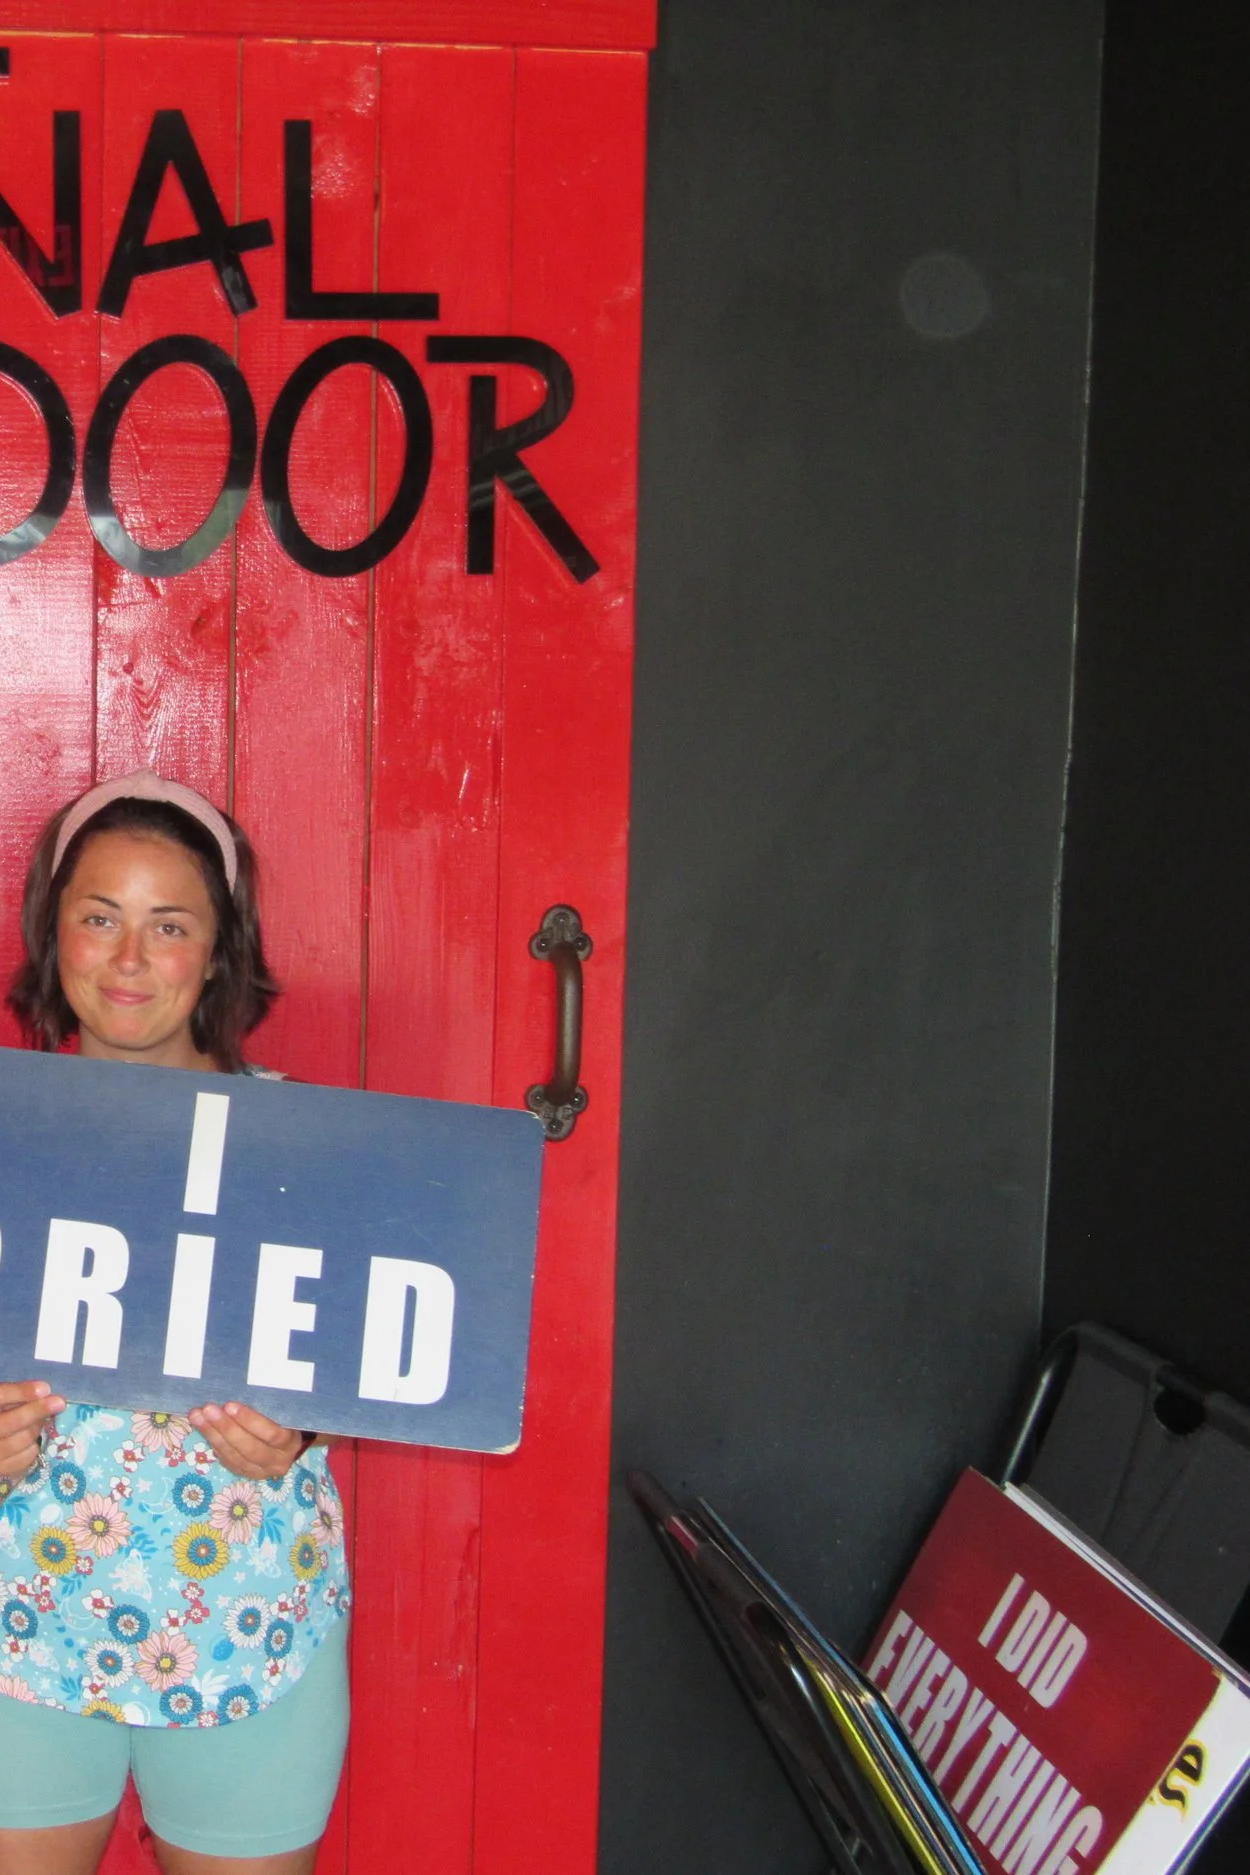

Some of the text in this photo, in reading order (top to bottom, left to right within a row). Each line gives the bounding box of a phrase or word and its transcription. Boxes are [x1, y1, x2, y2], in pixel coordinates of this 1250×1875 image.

[182, 1092, 230, 1215] I
[977, 1572, 1088, 1709] I DID
[866, 1609, 1105, 1875] EVERYTHING
